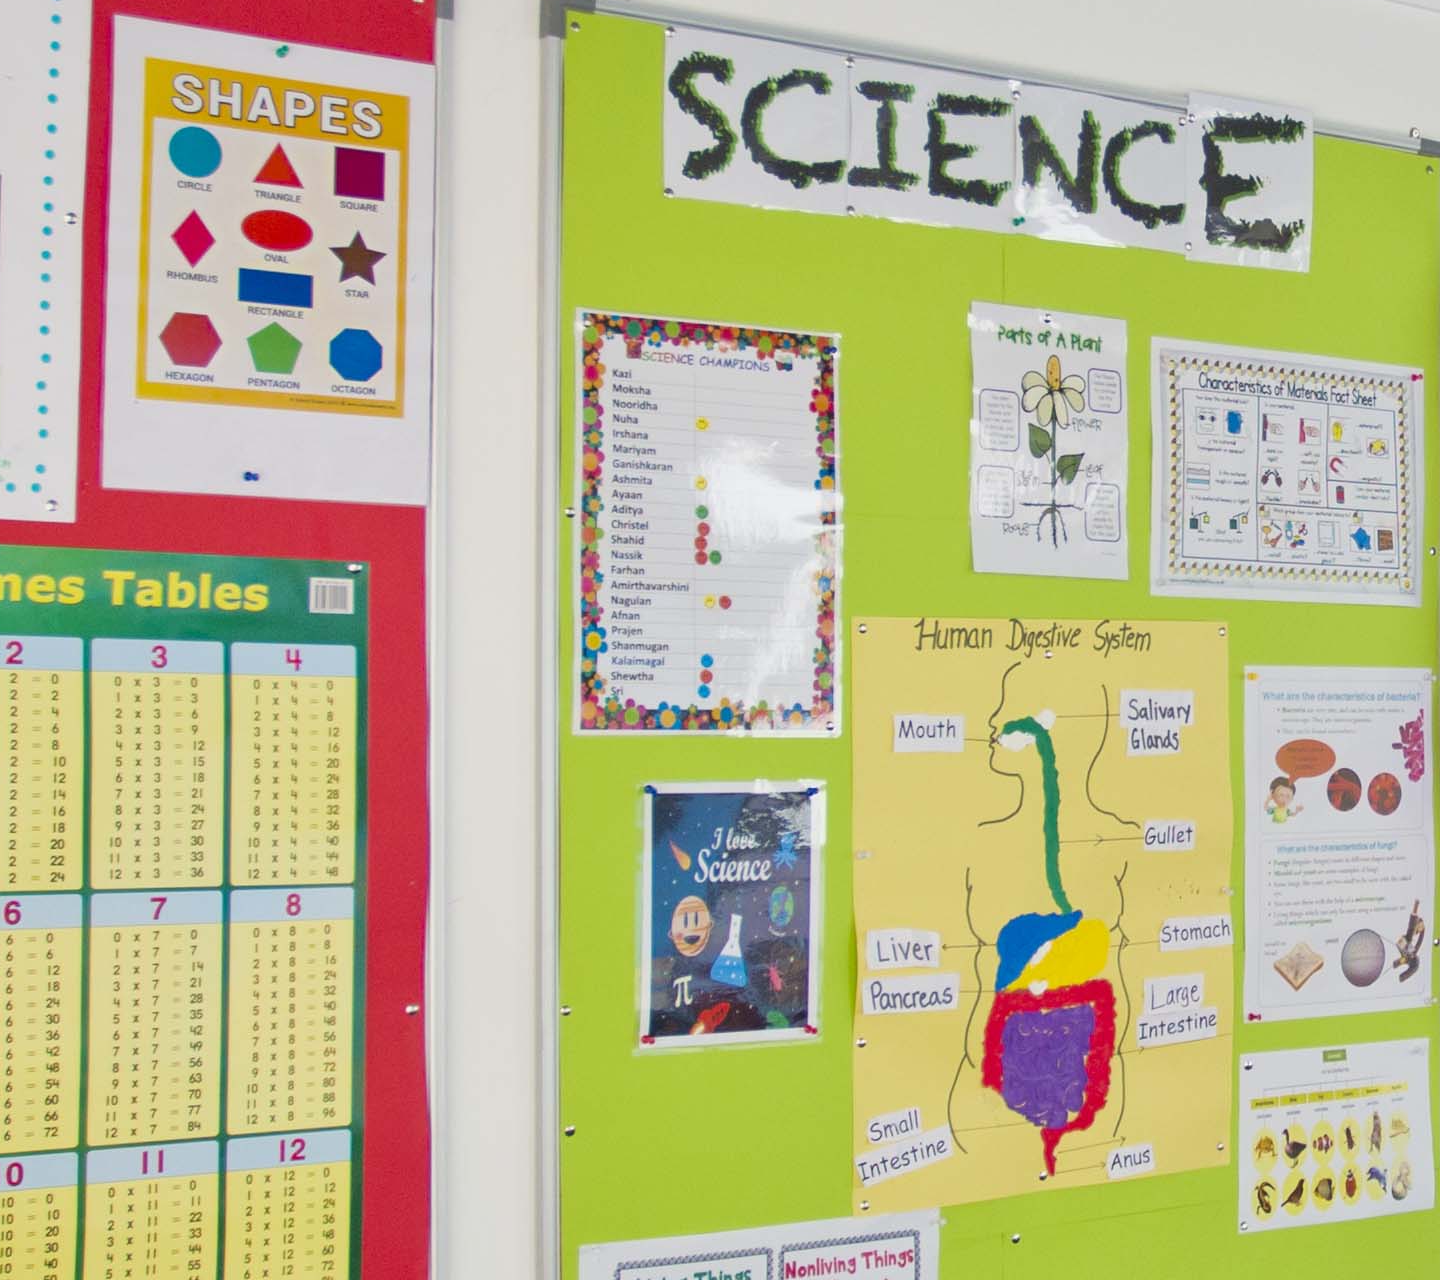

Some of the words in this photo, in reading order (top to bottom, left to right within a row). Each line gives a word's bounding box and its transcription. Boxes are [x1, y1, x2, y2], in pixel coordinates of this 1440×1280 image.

[171, 73, 384, 140] SHAPES
[668, 52, 1306, 253] SCIENCE
[177, 180, 213, 192] CIRCLE
[255, 190, 302, 203] TRIANGLE
[339, 201, 378, 213] SQUARE
[265, 253, 289, 264] OVAL
[167, 270, 218, 283] RHOMBUS
[345, 289, 369, 299] STAR
[248, 306, 304, 319] RECTANGLE
[642, 351, 694, 365] SCIENCE
[699, 356, 769, 372] CHAMPIONS
[165, 372, 214, 383] HEXAGON
[612, 368, 632, 380] Kazi
[248, 377, 301, 389] PENTAGON
[331, 385, 376, 396] OCTAGON
[612, 384, 652, 396] Moksha
[1198, 372, 1272, 397] Characteristics
[1274, 382, 1285, 397] of
[1287, 382, 1328, 403] Materials
[1330, 386, 1350, 407] Fact
[1352, 390, 1377, 408] Sheet
[612, 399, 658, 411] Nooridha
[612, 415, 638, 425] Nuha
[612, 429, 648, 440] Irshana
[612, 445, 656, 457] Mariyam
[612, 460, 673, 472] Ganishkaran
[612, 475, 653, 486] Ashmita
[611, 490, 643, 502] Ayaan
[611, 505, 643, 517] Aditya
[611, 520, 648, 531] Christel
[611, 534, 644, 545] Shahid
[611, 549, 643, 561] Nassik
[611, 565, 645, 576] Farhan
[103, 569, 270, 613] Tables
[611, 580, 689, 593] Amirthavarshini
[611, 610, 640, 621] Afnan
[611, 625, 643, 637] Prajen
[915, 618, 992, 651] Human
[1005, 619, 1081, 657] Digestive
[1093, 620, 1151, 657] System
[611, 641, 669, 653] Shanmugan
[610, 671, 654, 682] Shewtha
[1127, 698, 1191, 724] Salivary
[898, 720, 957, 739] Mouth
[1130, 728, 1180, 751] Glands
[1144, 826, 1193, 846] Gullet
[694, 848, 772, 883] Science
[1161, 920, 1231, 942] Stomach
[876, 939, 934, 963] Liver
[870, 982, 953, 1011] Pancreas
[1150, 980, 1201, 1010] Large
[1138, 1012, 1217, 1041] Intestine
[869, 1109, 920, 1141] Small
[278, 1139, 306, 1162] 12
[141, 1151, 165, 1174] 11
[858, 1137, 948, 1182] Intestine
[1111, 1148, 1151, 1169] Anus
[785, 1256, 856, 1279] Nonliving
[862, 1248, 914, 1270] Things
